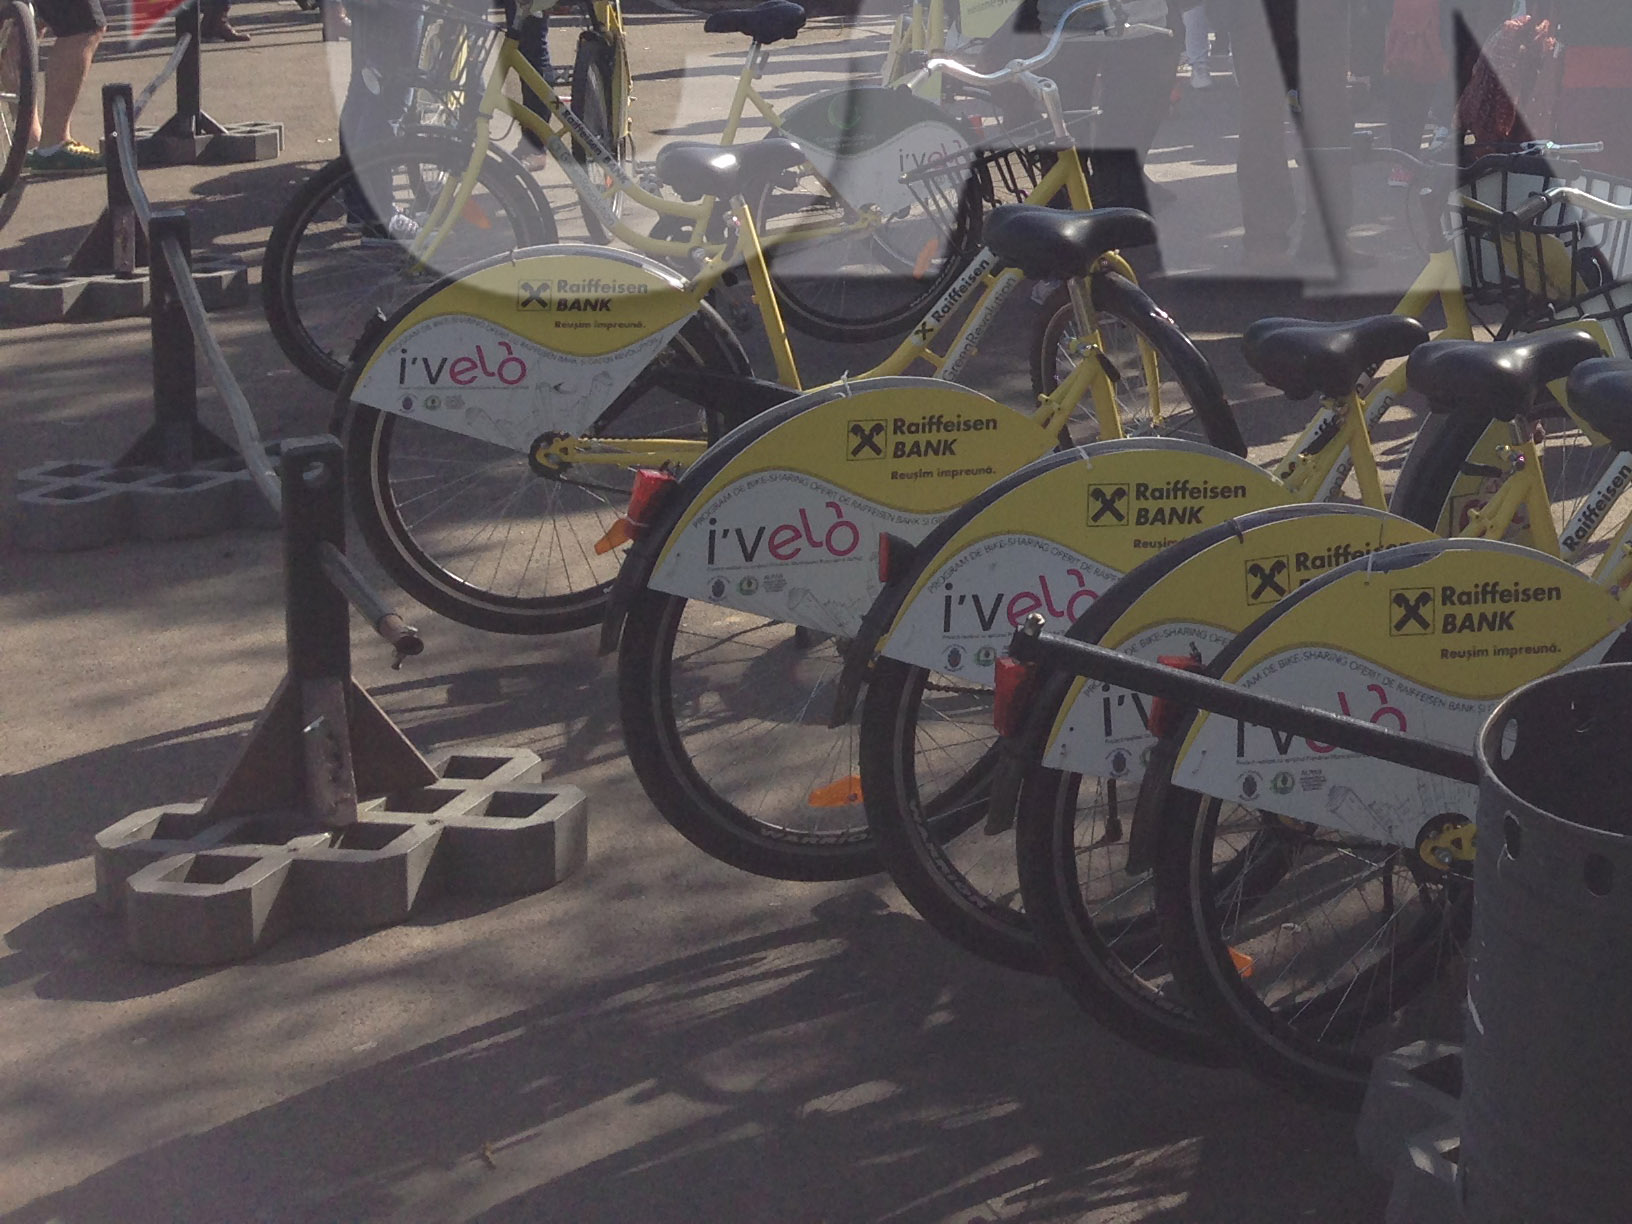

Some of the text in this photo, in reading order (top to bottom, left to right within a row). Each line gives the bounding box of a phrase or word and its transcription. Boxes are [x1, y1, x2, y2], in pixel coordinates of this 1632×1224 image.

[556, 278, 649, 295] Raiffeisen
[932, 258, 990, 324] Raiffeisen
[556, 297, 612, 313] BANK
[892, 414, 998, 436] Raiffeisen
[892, 438, 958, 459] BANK
[1135, 480, 1248, 502] Raiffeisen
[1135, 505, 1205, 526] BANK
[1562, 462, 1632, 553] Raiffeisen
[1441, 581, 1562, 607] Raiffeisen
[1441, 610, 1516, 634] BANK
